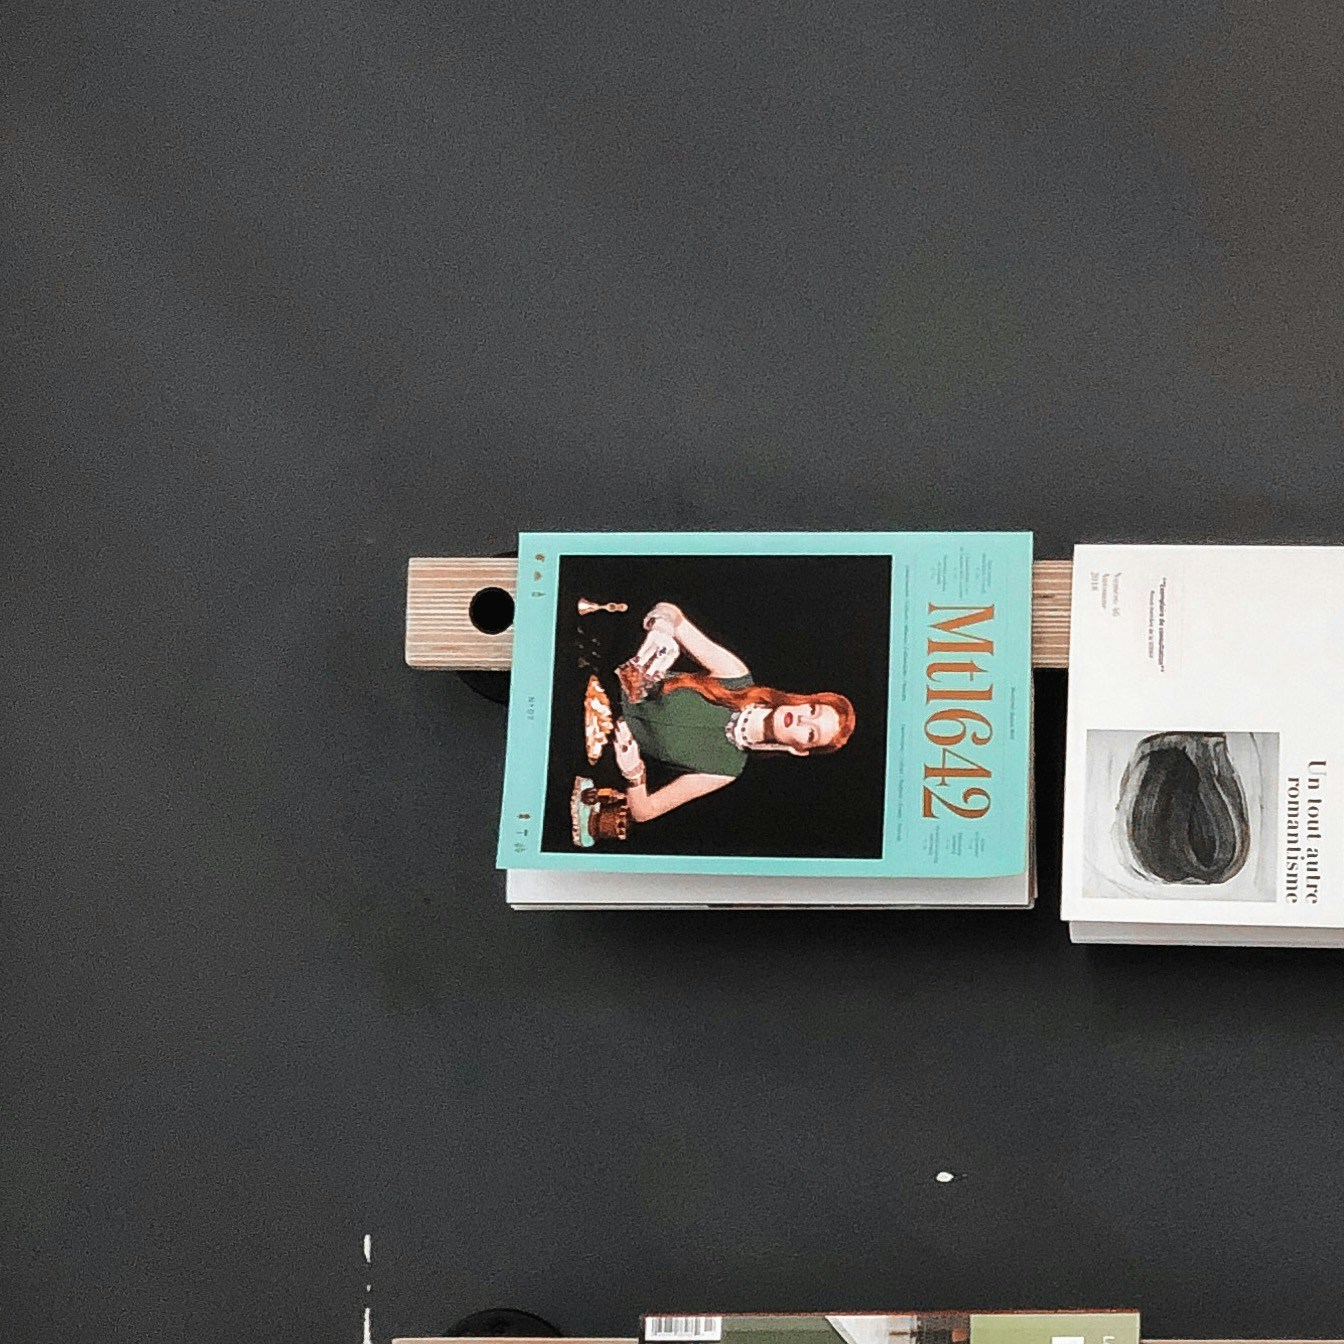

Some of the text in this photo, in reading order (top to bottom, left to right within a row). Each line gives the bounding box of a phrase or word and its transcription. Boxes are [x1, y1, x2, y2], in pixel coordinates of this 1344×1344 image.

[1285, 777, 1304, 904] romantisme
[1305, 760, 1327, 905] Un tout autre
